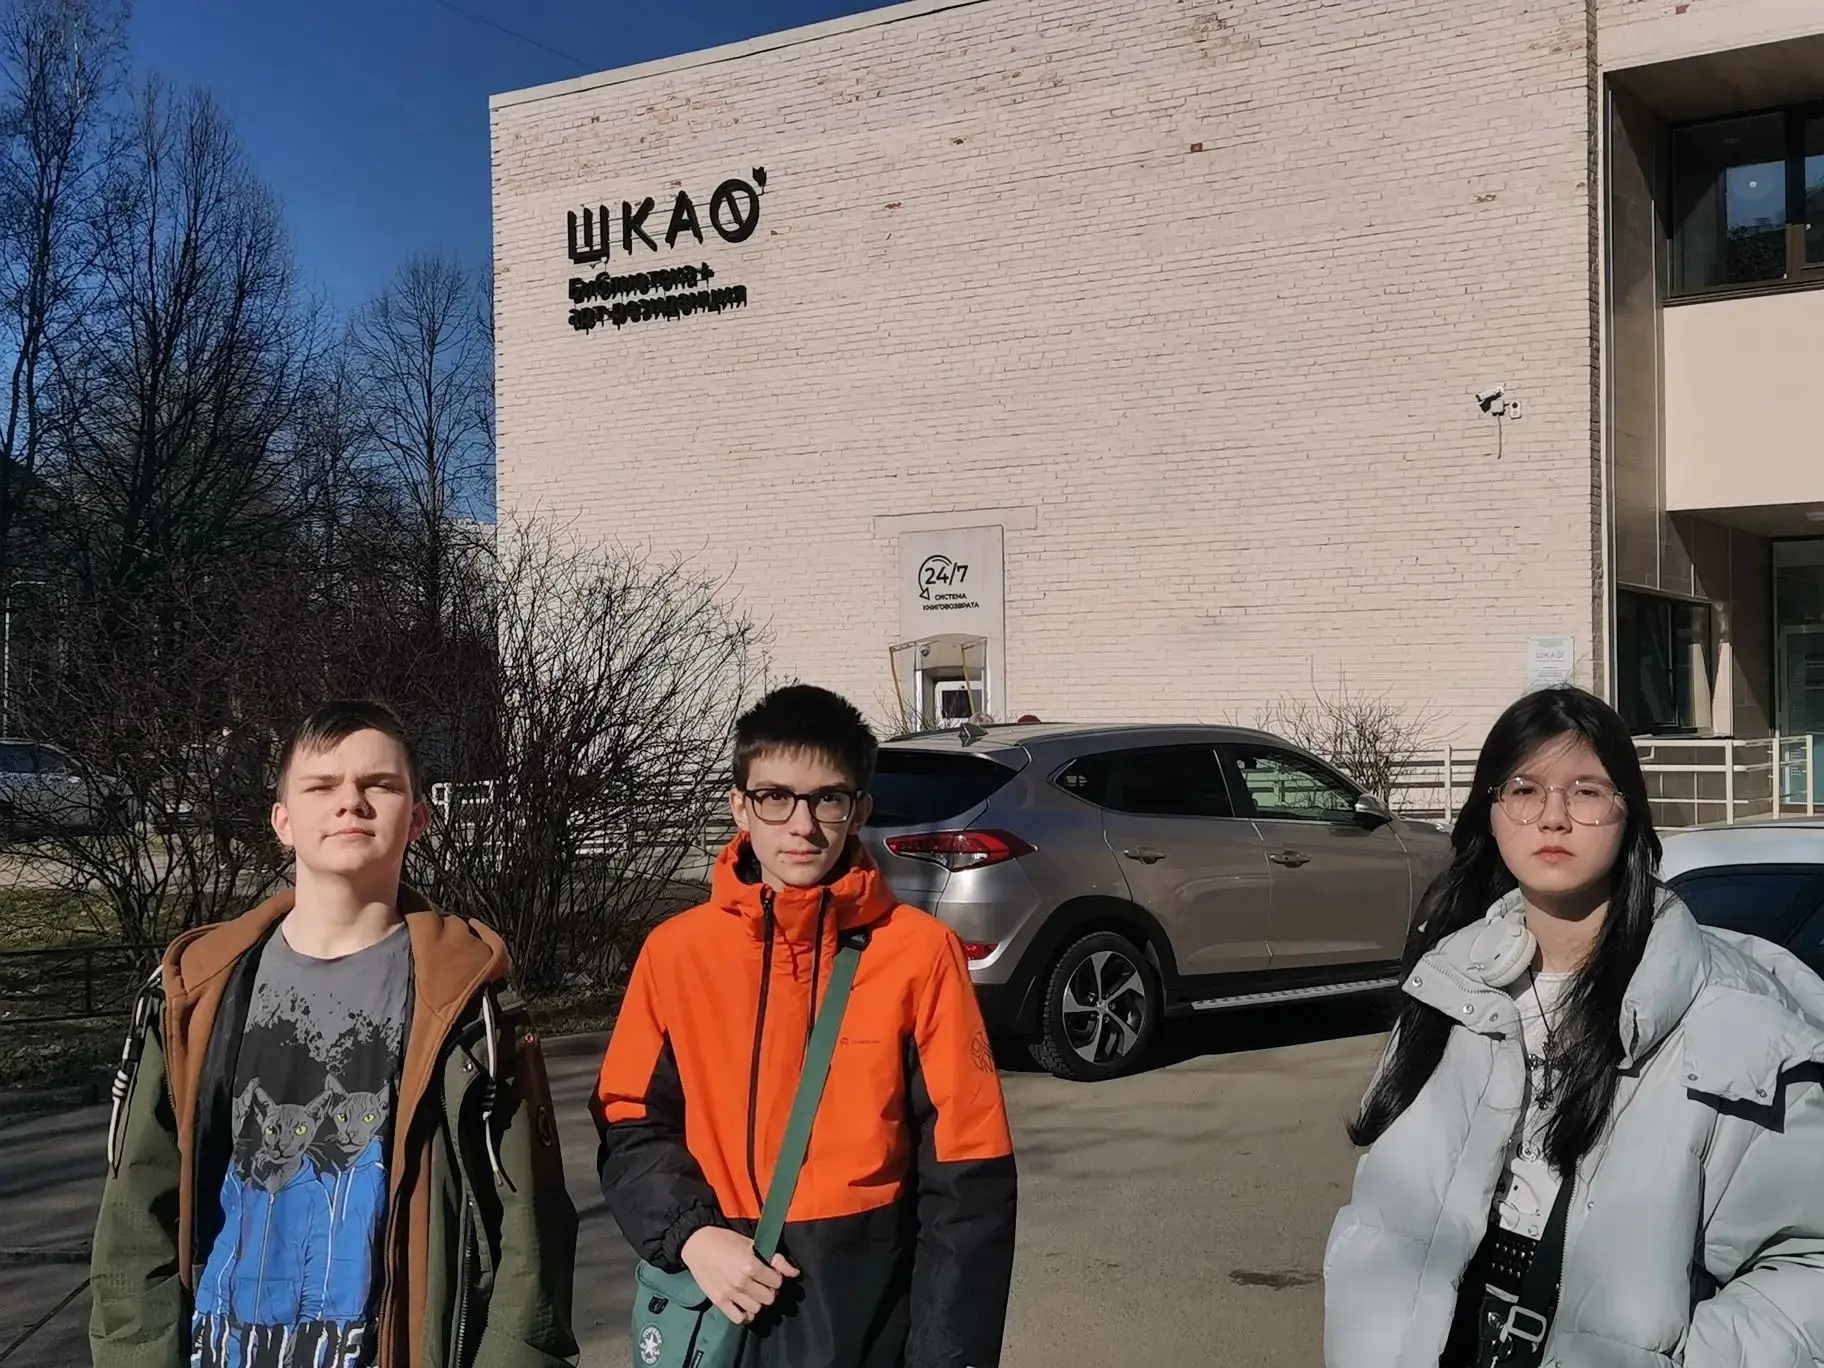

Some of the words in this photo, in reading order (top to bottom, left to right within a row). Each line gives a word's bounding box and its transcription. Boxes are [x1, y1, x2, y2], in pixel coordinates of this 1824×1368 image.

[924, 562, 969, 586] 24/7
[934, 592, 967, 601] СИСТЕМА
[922, 601, 980, 611] КНИГОВОЗВРАТА
